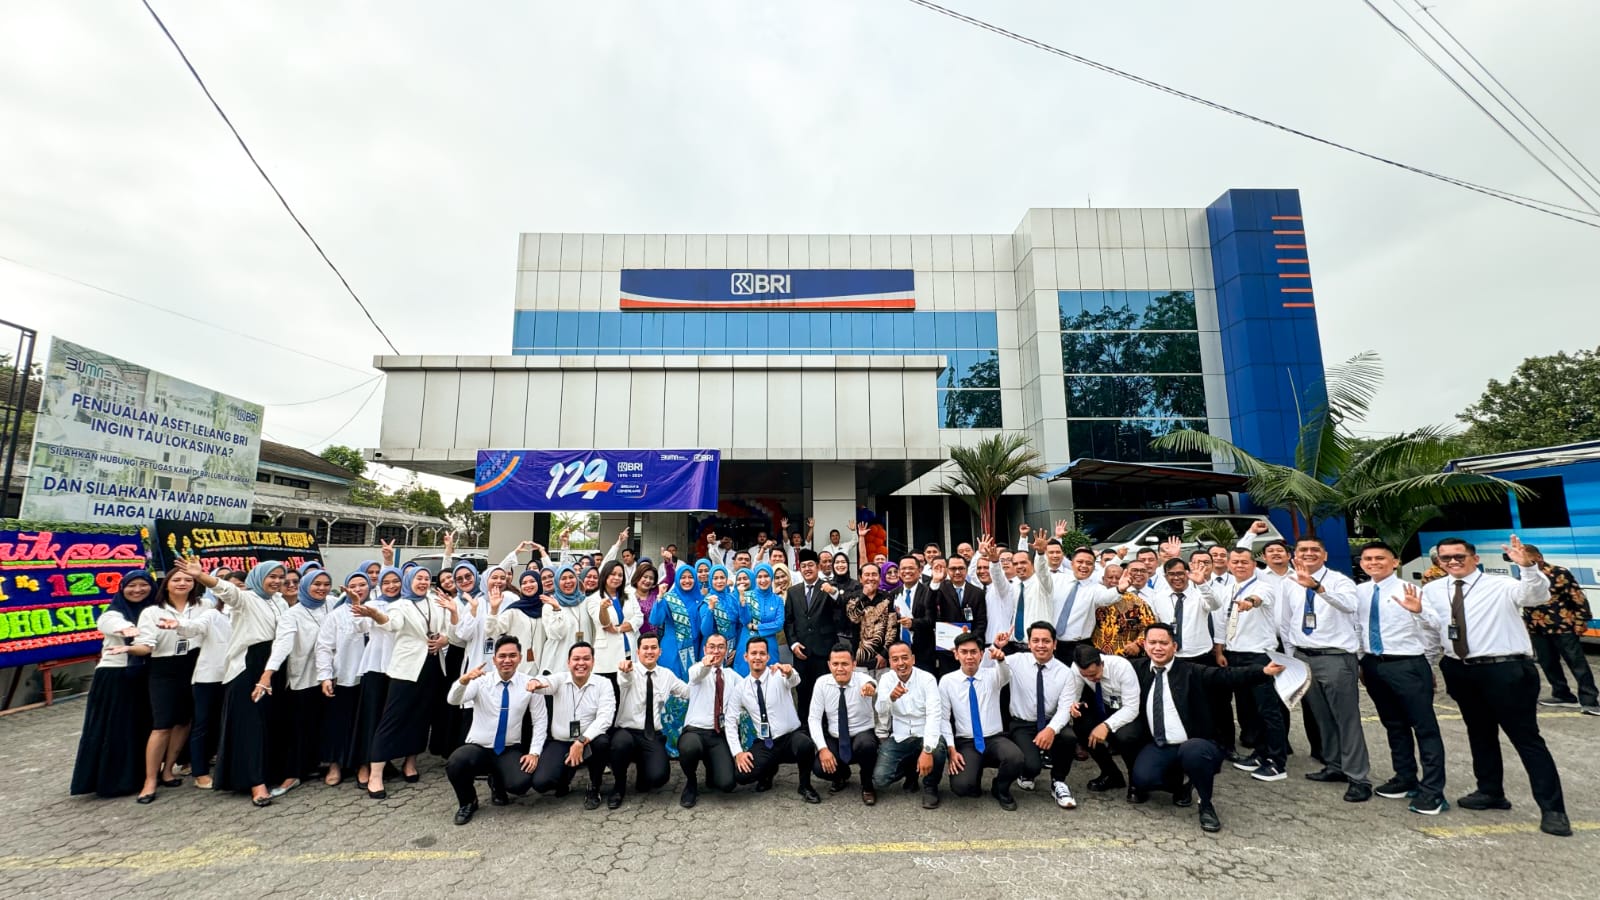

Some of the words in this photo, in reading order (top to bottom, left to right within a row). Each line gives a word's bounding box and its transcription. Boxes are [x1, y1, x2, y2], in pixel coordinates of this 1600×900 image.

[755, 274, 791, 294] BRI
[72, 393, 158, 425] PENJUALAN
[160, 418, 191, 434] ASET
[192, 424, 231, 442] LELANG
[233, 435, 248, 447] BRI
[246, 411, 259, 424] BRI
[91, 418, 133, 438] INGIN
[137, 428, 163, 444] TAU
[165, 435, 234, 458] LOKASINYA?
[49, 446, 98, 461] SILAHKAN
[99, 453, 138, 466] HUBUNGI
[139, 460, 172, 473] PETUGAS
[173, 466, 192, 475] KAMI
[627, 462, 643, 471] BRI
[43, 476, 82, 493] DAN
[85, 480, 157, 501] SILAHKAN
[160, 490, 204, 505] TAWAR
[205, 495, 248, 509] DENGAN
[545, 458, 609, 500] 129
[93, 502, 145, 519] HARGA
[149, 507, 181, 520] LAKU
[183, 510, 215, 523] ANDA
[0, 531, 145, 568] ukses
[192, 528, 248, 548] SELAMAT
[47, 572, 123, 597] 129
